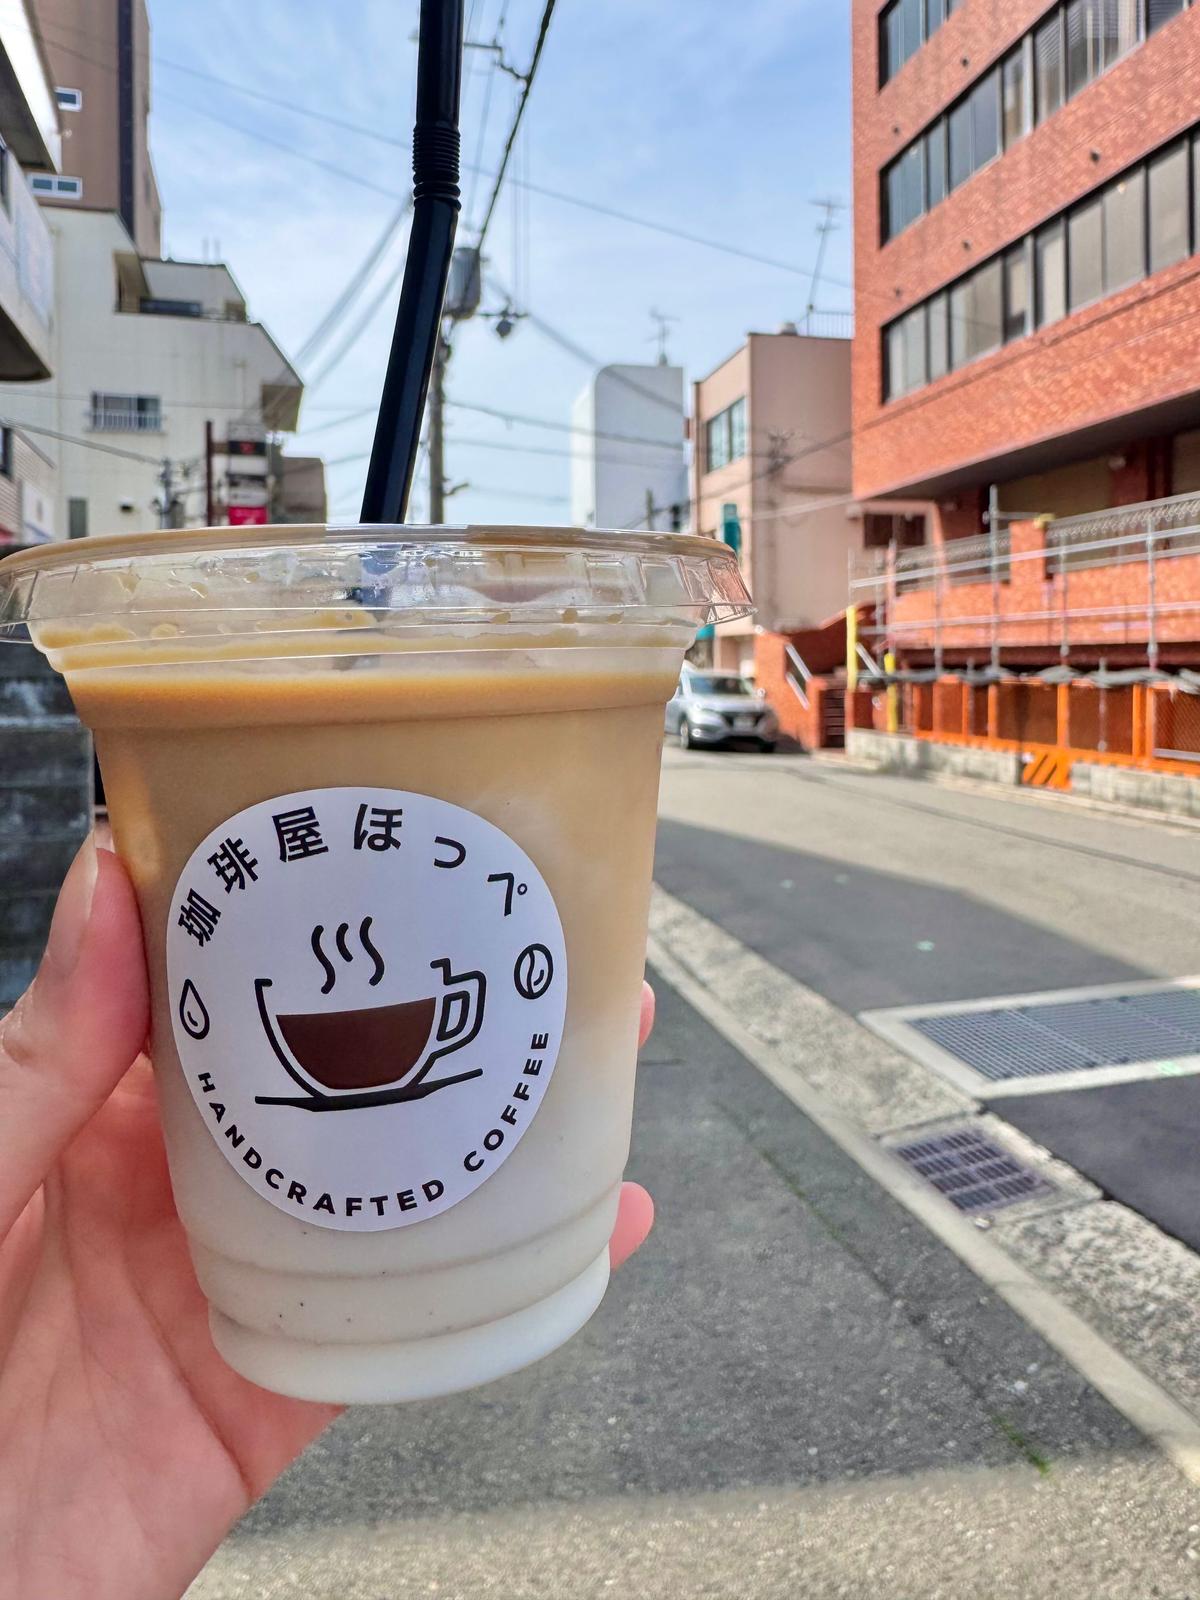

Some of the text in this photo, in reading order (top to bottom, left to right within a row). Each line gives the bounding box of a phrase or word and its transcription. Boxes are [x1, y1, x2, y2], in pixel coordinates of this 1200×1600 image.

[177, 803, 529, 948] 珈琲屋ほっぺ
[197, 1032, 550, 1217] HANDCRAFTED COFFEE
